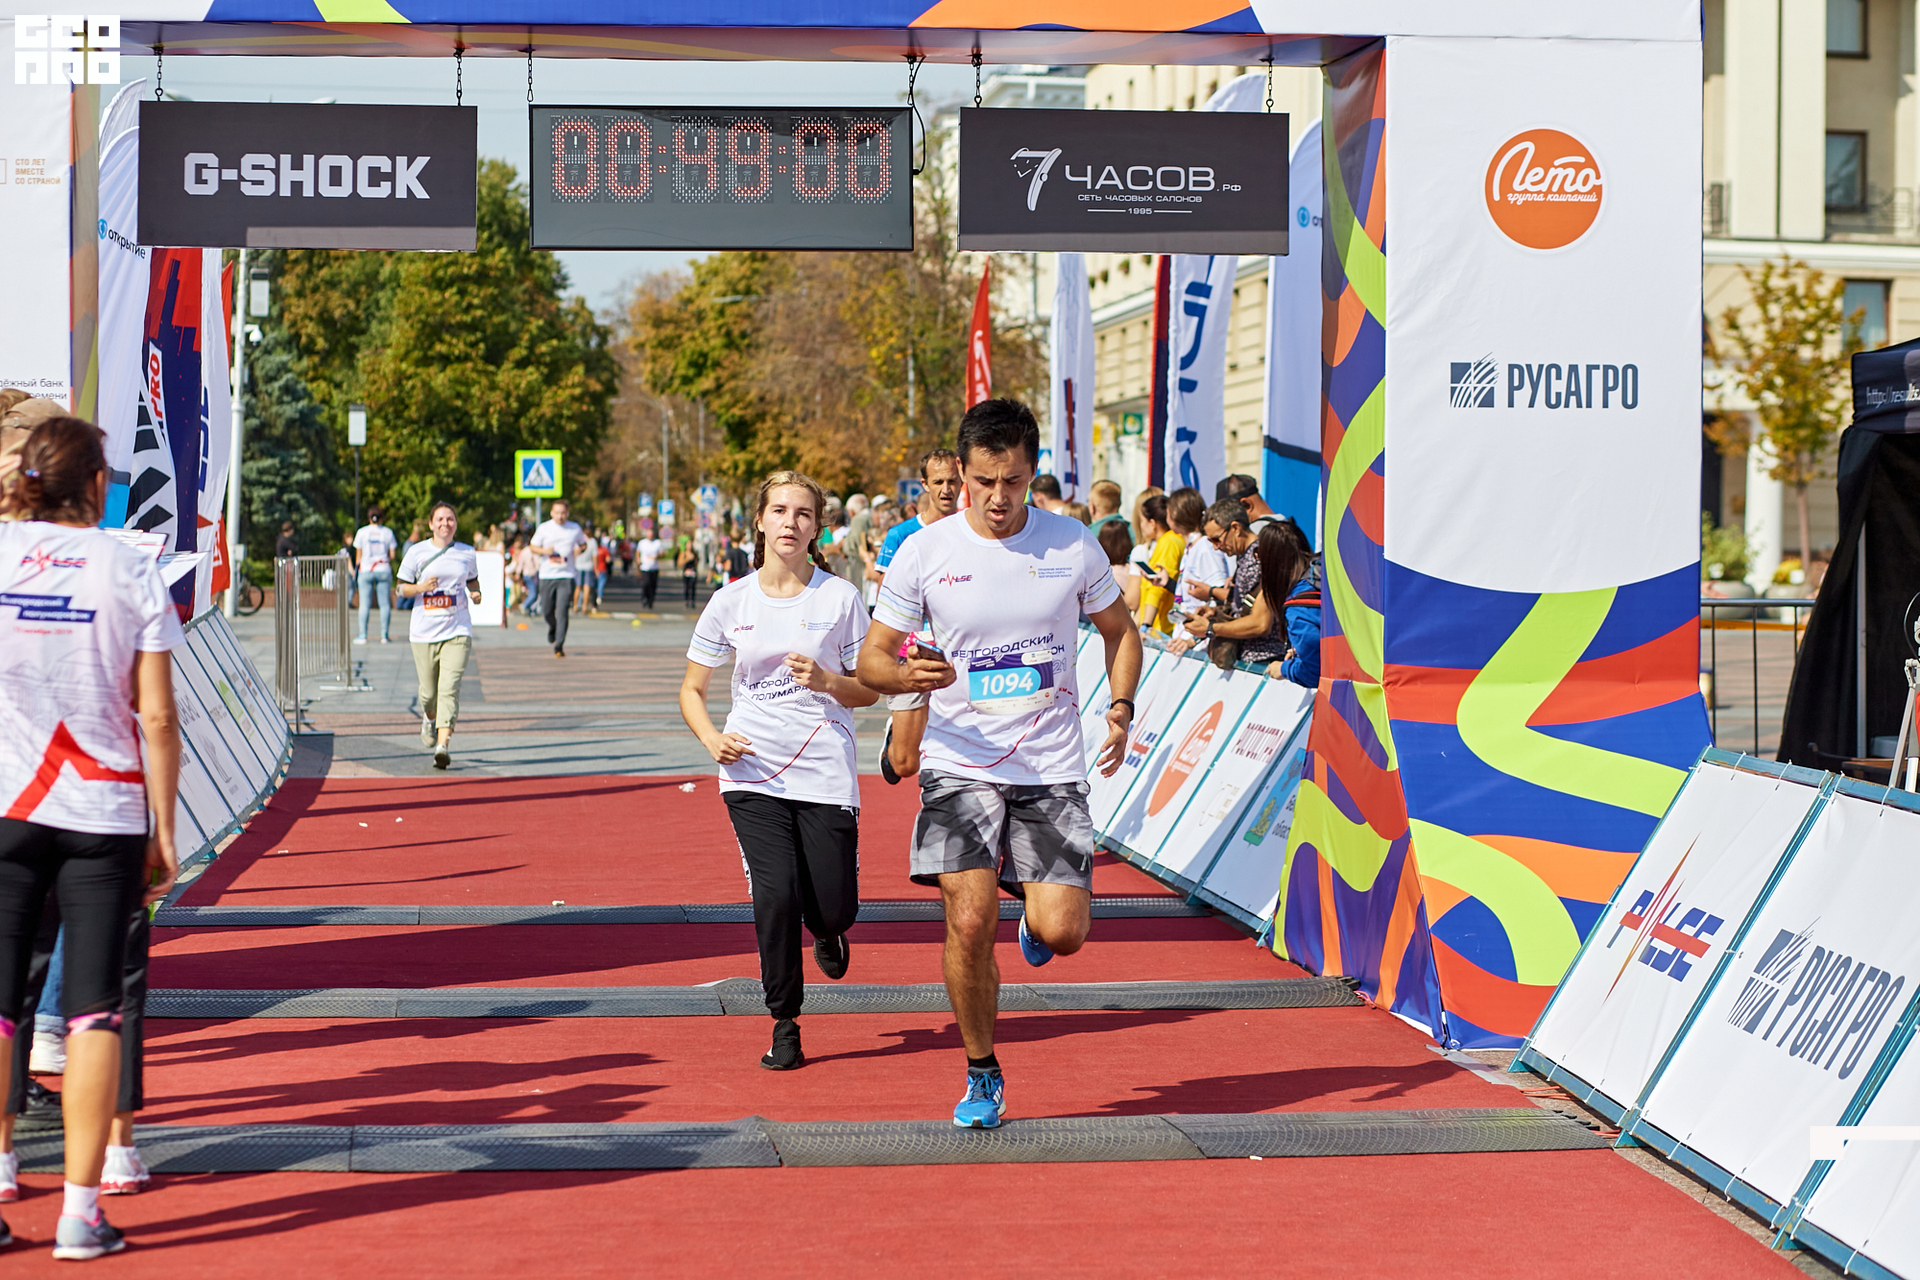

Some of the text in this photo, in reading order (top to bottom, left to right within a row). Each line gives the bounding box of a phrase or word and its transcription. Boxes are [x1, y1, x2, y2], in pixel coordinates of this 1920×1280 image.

[15, 158, 46, 166] СТО ЛЕТ
[555, 120, 889, 197] 00:49:00
[1492, 140, 1603, 201] Лето
[15, 177, 61, 185] СО СТРАНОЙ
[184, 152, 431, 198] G-SHOCK
[1010, 147, 1062, 212] 7
[1077, 194, 1203, 203] СЕТЬ ЧАСОВЫХ САЛОНОВ
[1127, 207, 1153, 215] 1995
[1507, 191, 1599, 206] группа компаний
[108, 229, 146, 259] открытие
[40, 377, 64, 388] банк
[1507, 363, 1639, 409] РУСАГРО
[426, 597, 449, 608] 5501
[951, 632, 1055, 658] БЕЛГОРОДСКИЙ
[981, 671, 1034, 696] 1094
[1761, 945, 1906, 1080] РУСАГРО
